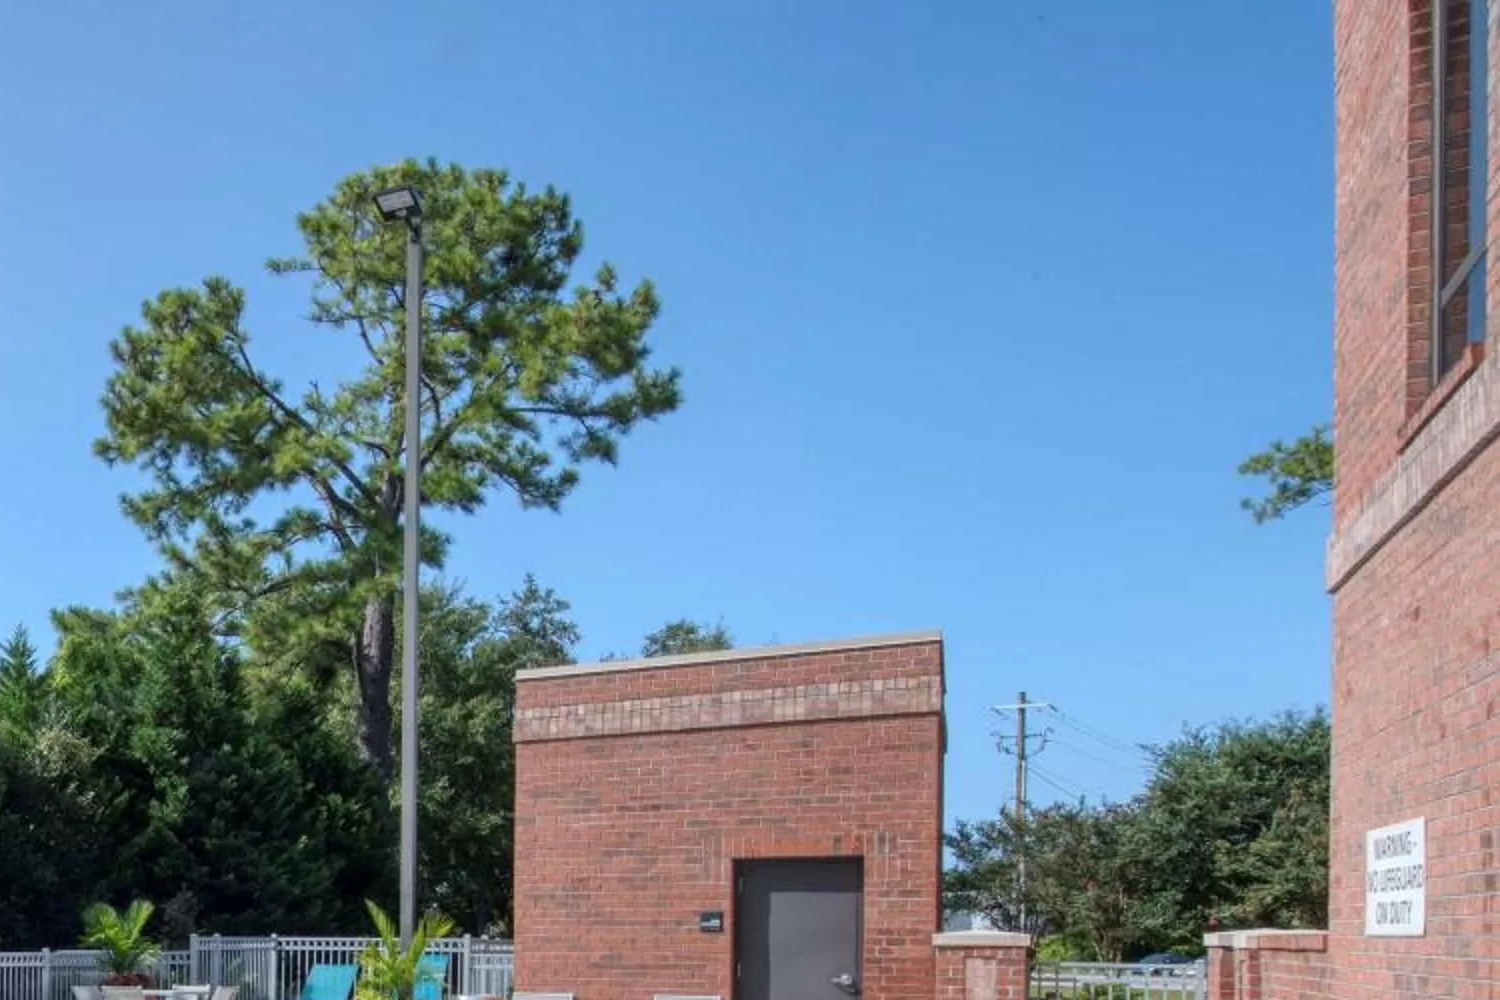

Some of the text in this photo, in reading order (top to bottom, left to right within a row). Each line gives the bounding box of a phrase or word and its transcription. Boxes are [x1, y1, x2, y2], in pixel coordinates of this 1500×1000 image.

[1367, 863, 1423, 893] NO LIFEGUARD
[1376, 900, 1413, 925] ON DUTY
